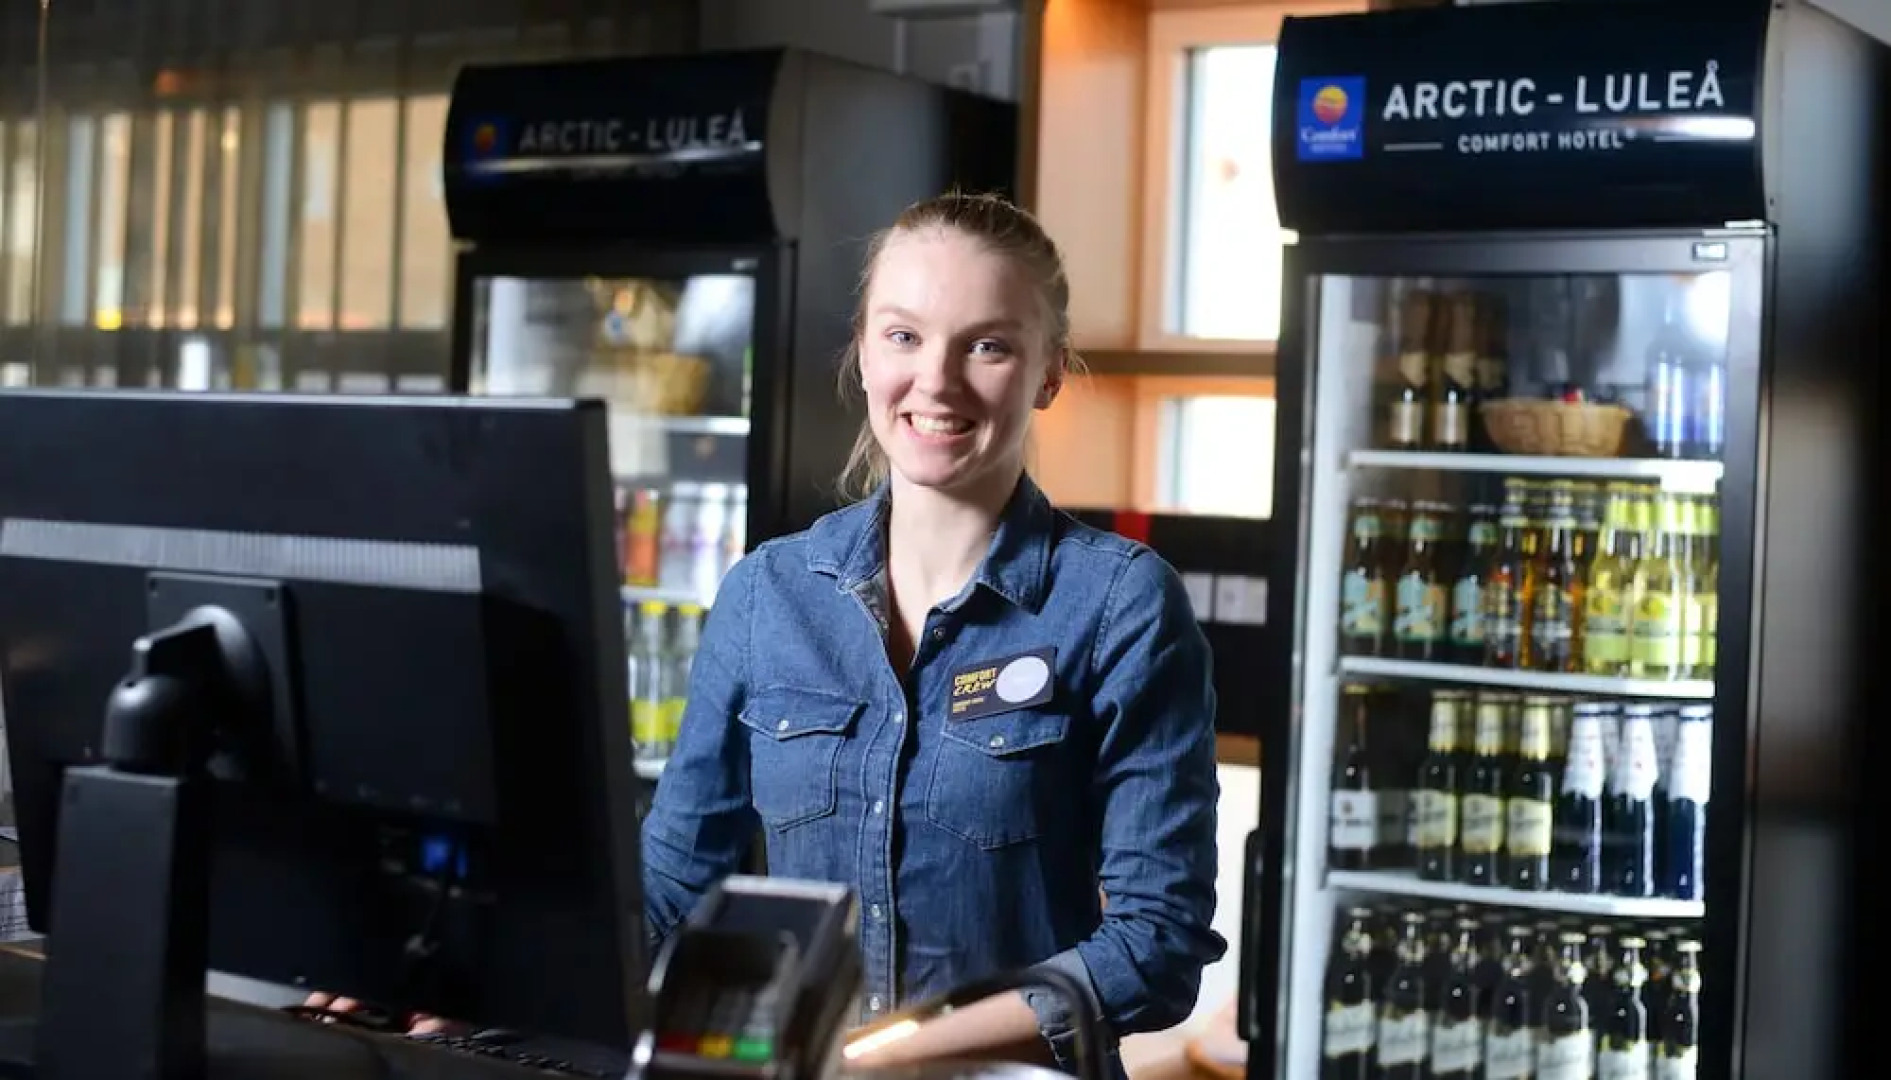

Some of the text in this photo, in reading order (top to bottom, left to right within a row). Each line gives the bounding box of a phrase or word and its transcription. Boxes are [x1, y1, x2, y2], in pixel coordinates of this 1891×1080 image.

[1383, 78, 1536, 121] ARCTIC
[1576, 59, 1725, 113] LULEÅ
[518, 119, 622, 152] ARCTIC
[646, 106, 749, 150] LULEÅ
[1457, 131, 1550, 154] COMFORT
[954, 667, 998, 686] COMFORT
